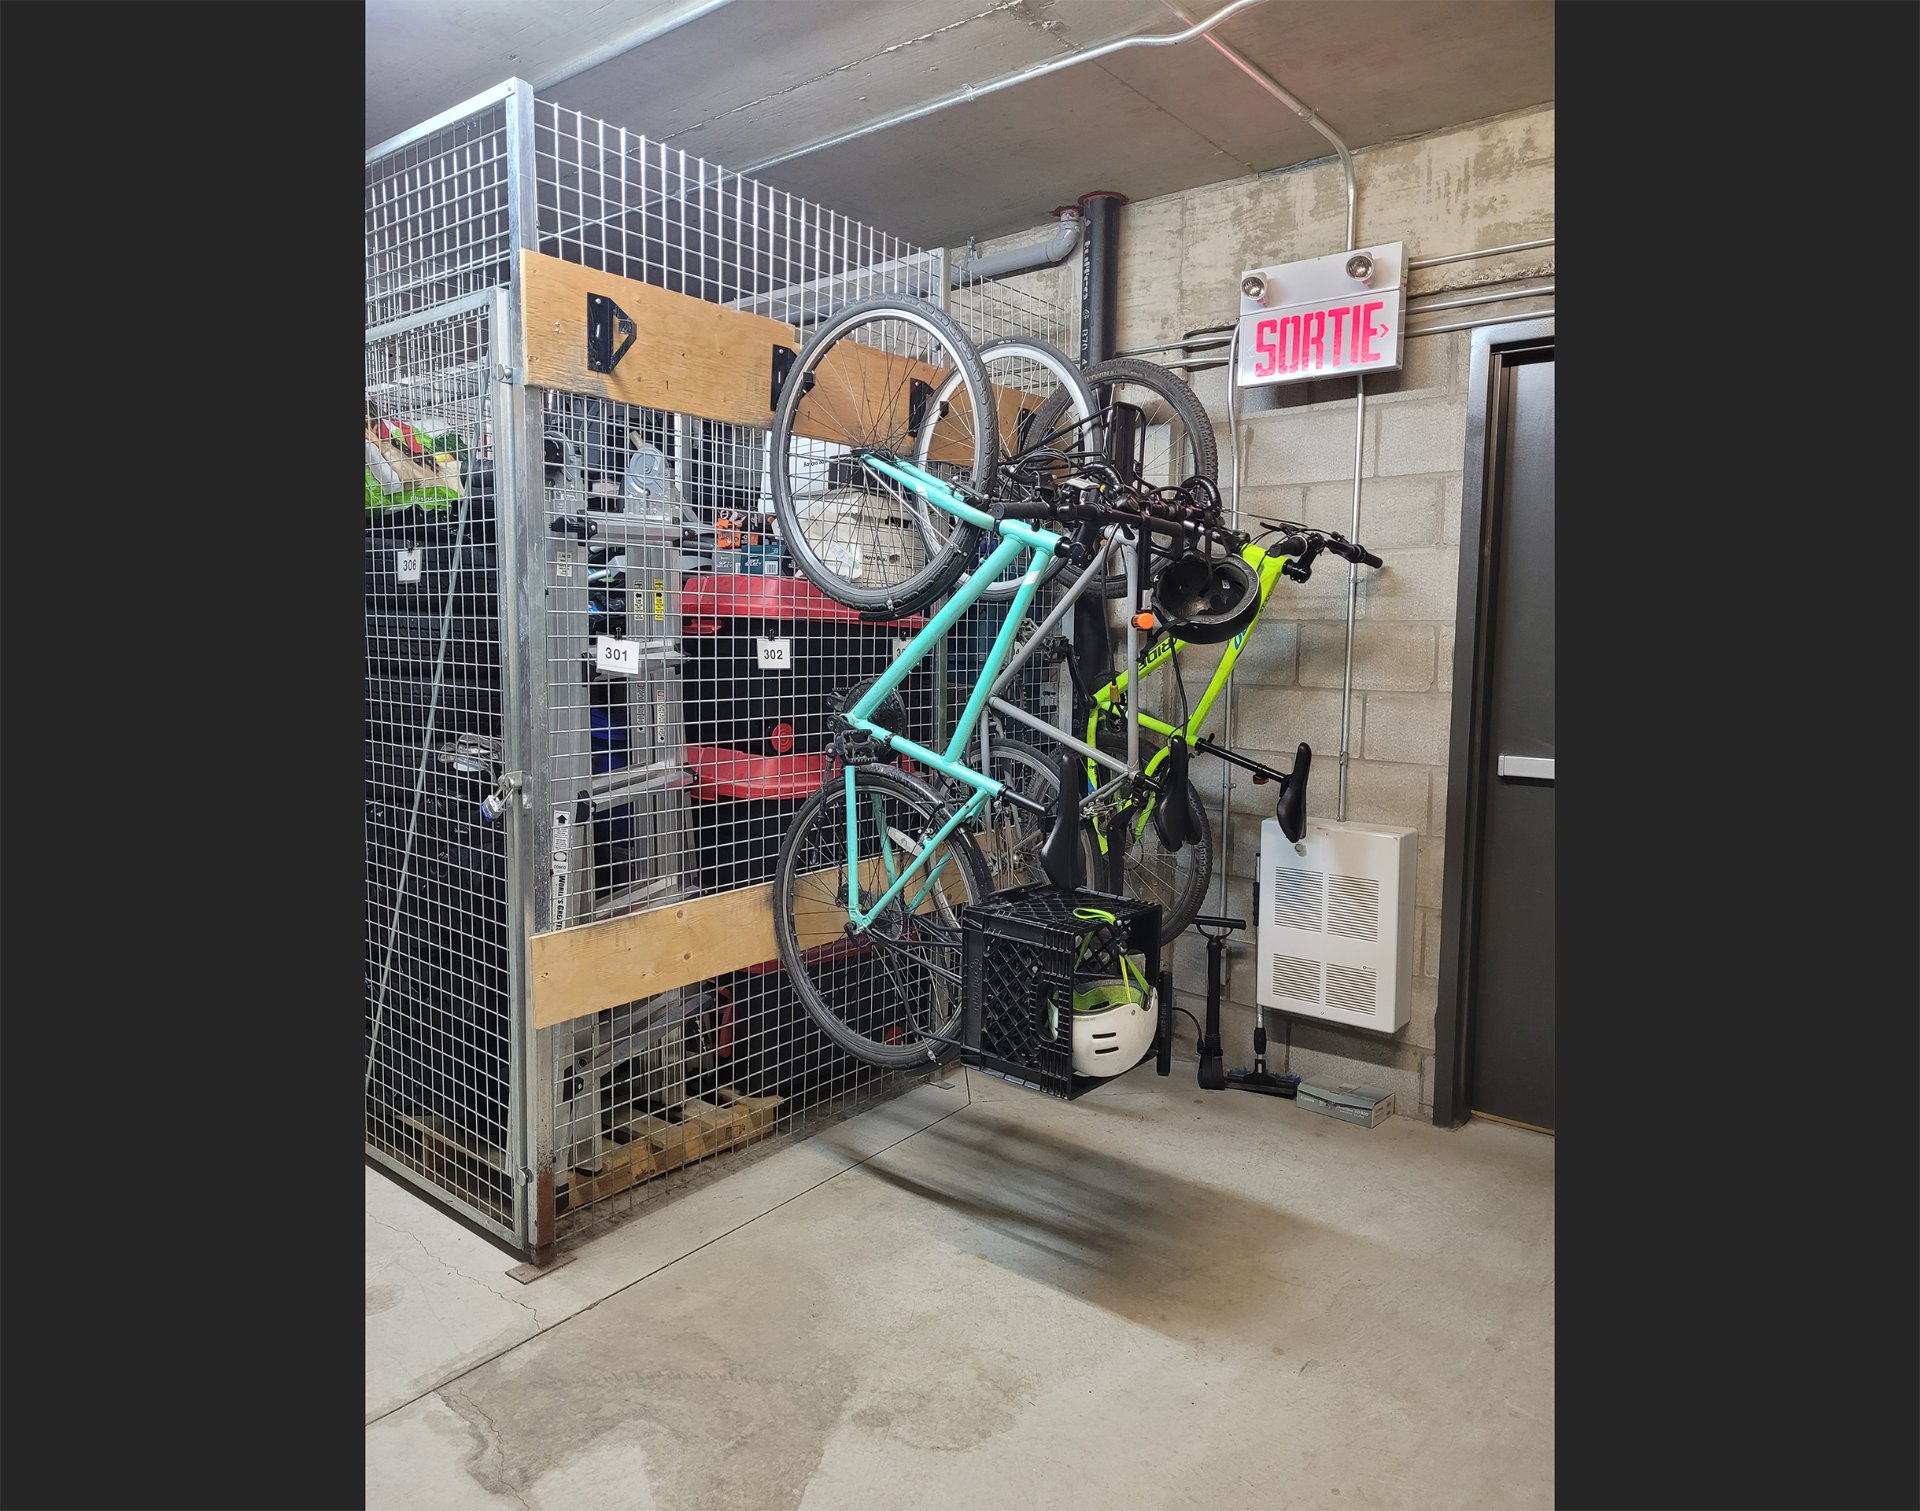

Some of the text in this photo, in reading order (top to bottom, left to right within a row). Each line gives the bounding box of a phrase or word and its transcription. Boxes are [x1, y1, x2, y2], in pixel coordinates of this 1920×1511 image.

[1255, 302, 1383, 377] SORTIE
[402, 559, 417, 572] 306
[605, 647, 628, 662] 301
[763, 649, 783, 660] 302
